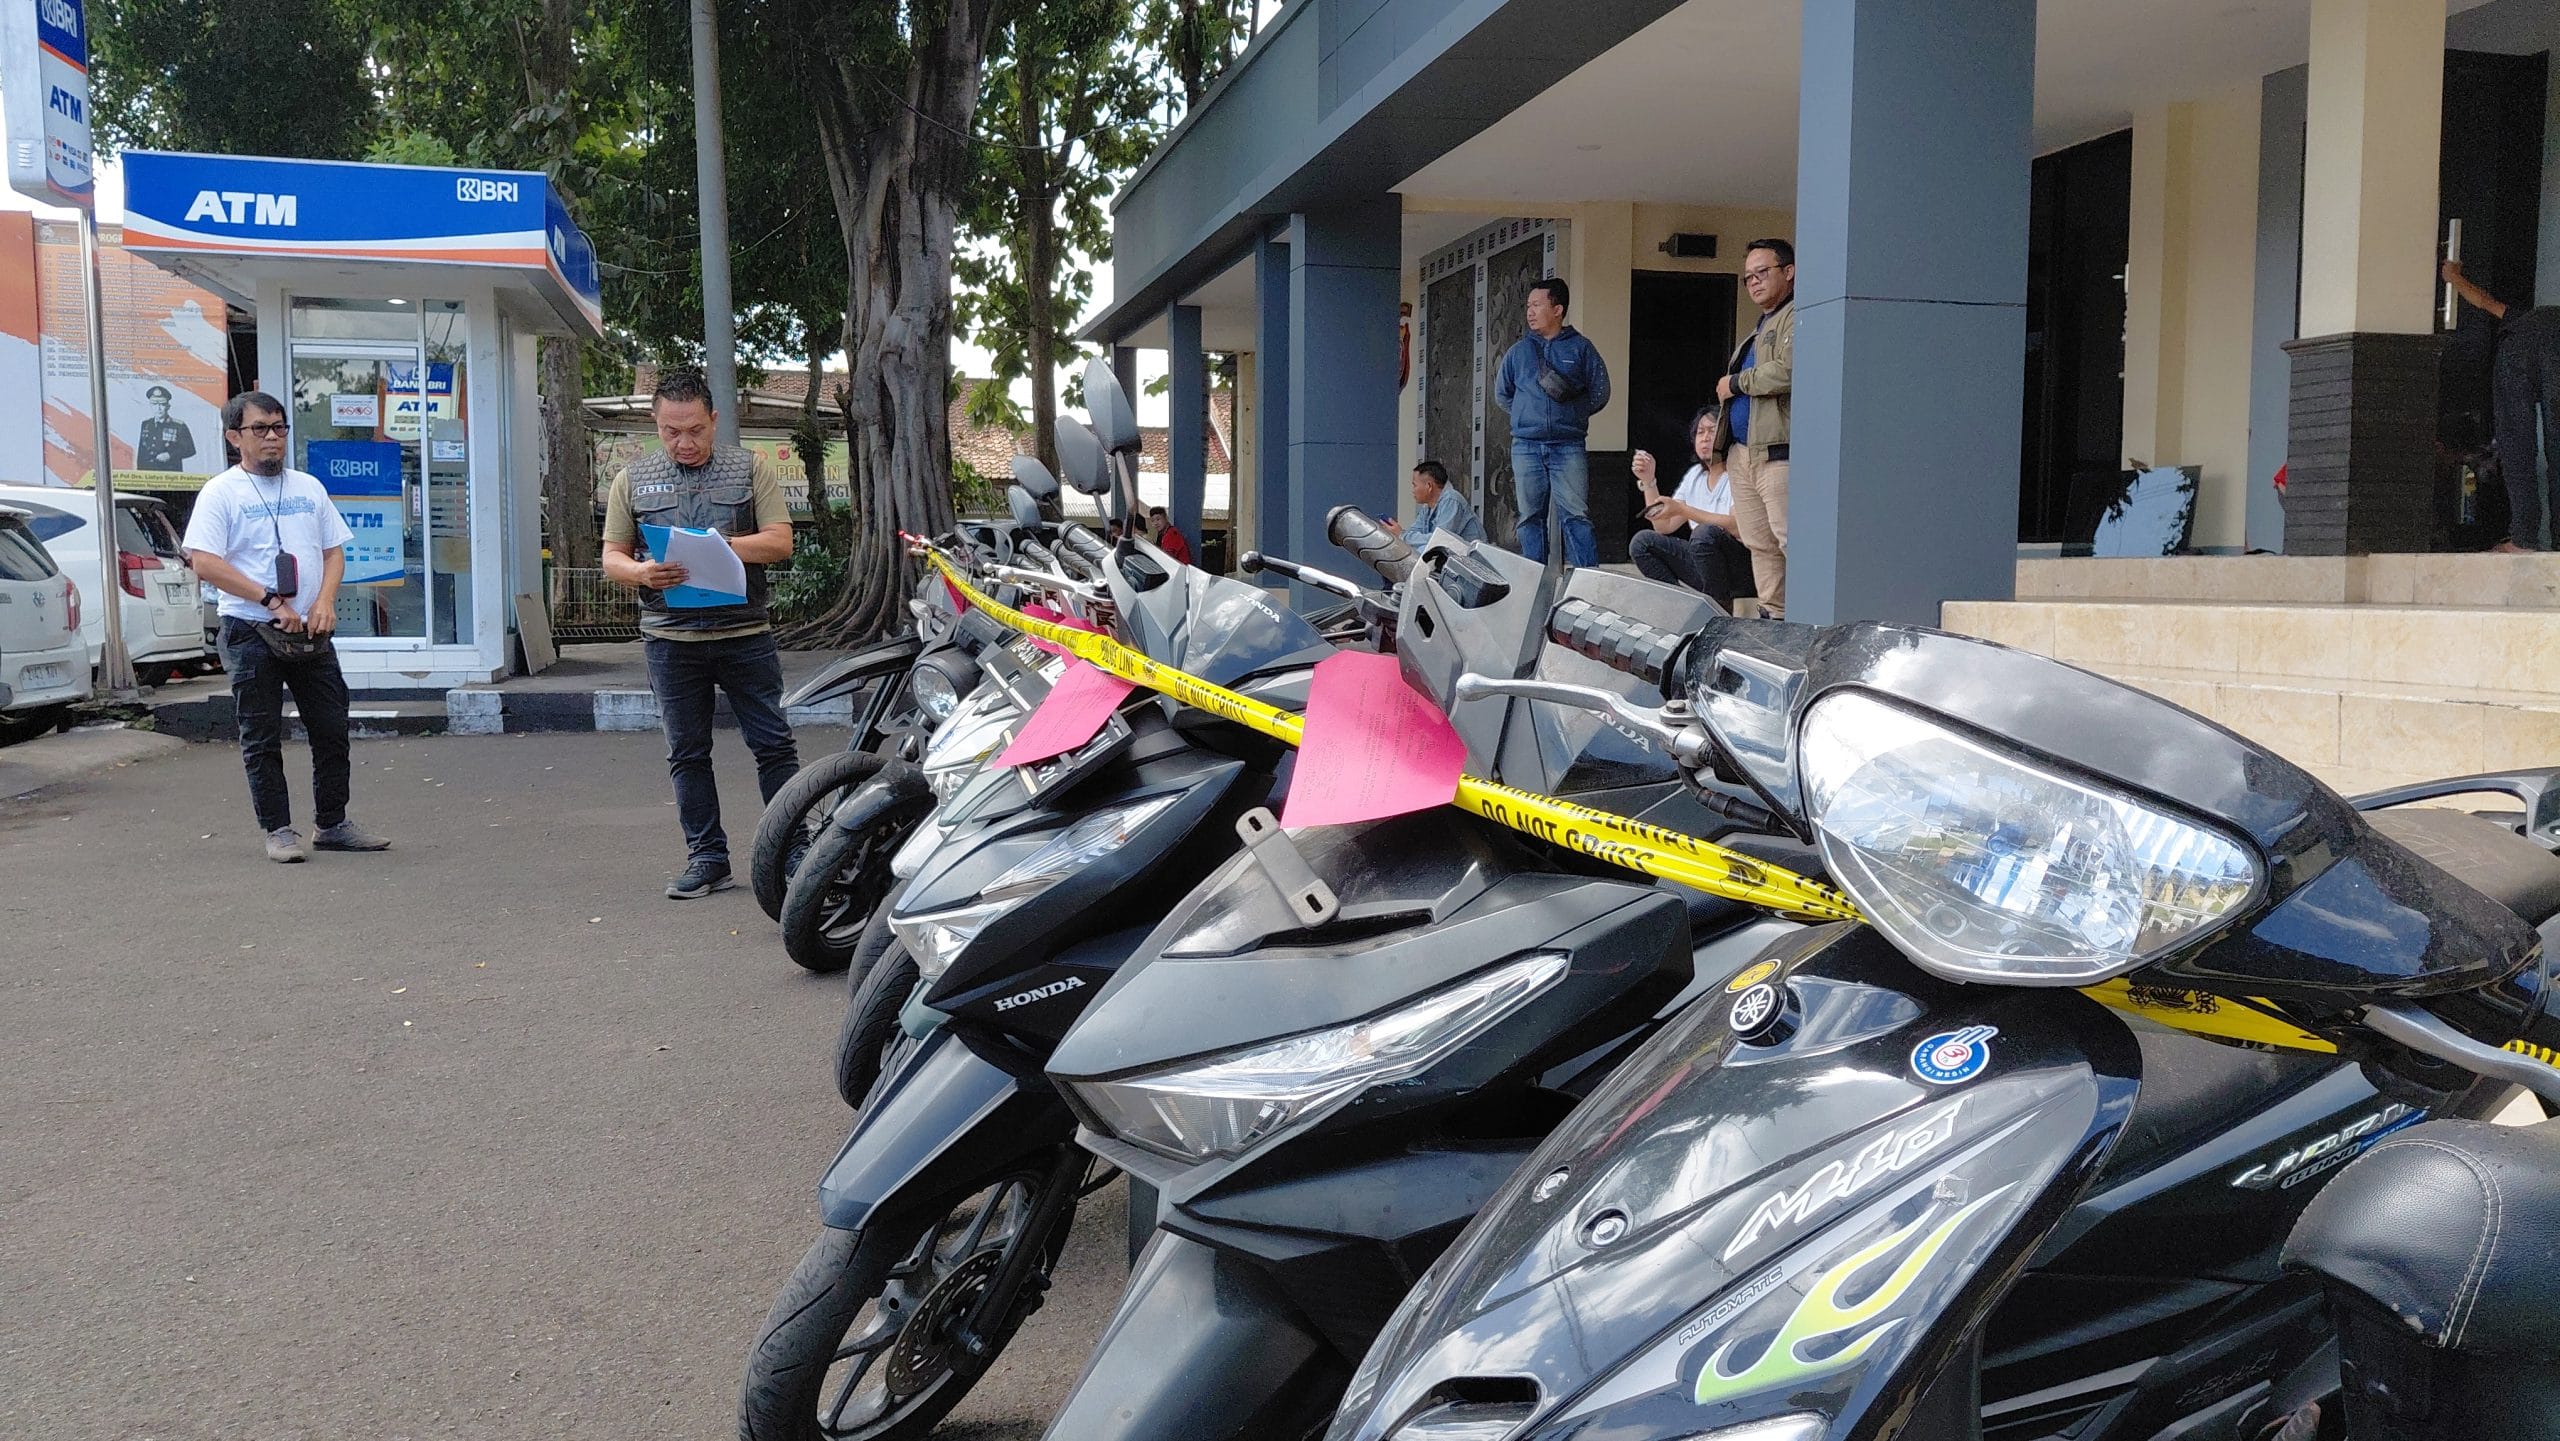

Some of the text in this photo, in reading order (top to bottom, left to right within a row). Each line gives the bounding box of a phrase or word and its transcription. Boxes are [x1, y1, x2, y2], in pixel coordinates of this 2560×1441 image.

[54, 2, 78, 38] BRI
[50, 85, 83, 124] ATM
[184, 190, 297, 227] ATM
[481, 180, 518, 203] BRI
[393, 380, 446, 389] BAN BRI
[397, 401, 438, 412] ATM
[350, 461, 378, 476] BRI
[641, 486, 671, 494] JOEL
[1481, 799, 1511, 825] DO
[1516, 811, 1558, 845] NOT
[993, 976, 1086, 1012] HONDA
[1679, 1266, 1783, 1345] AUTOMATIC
